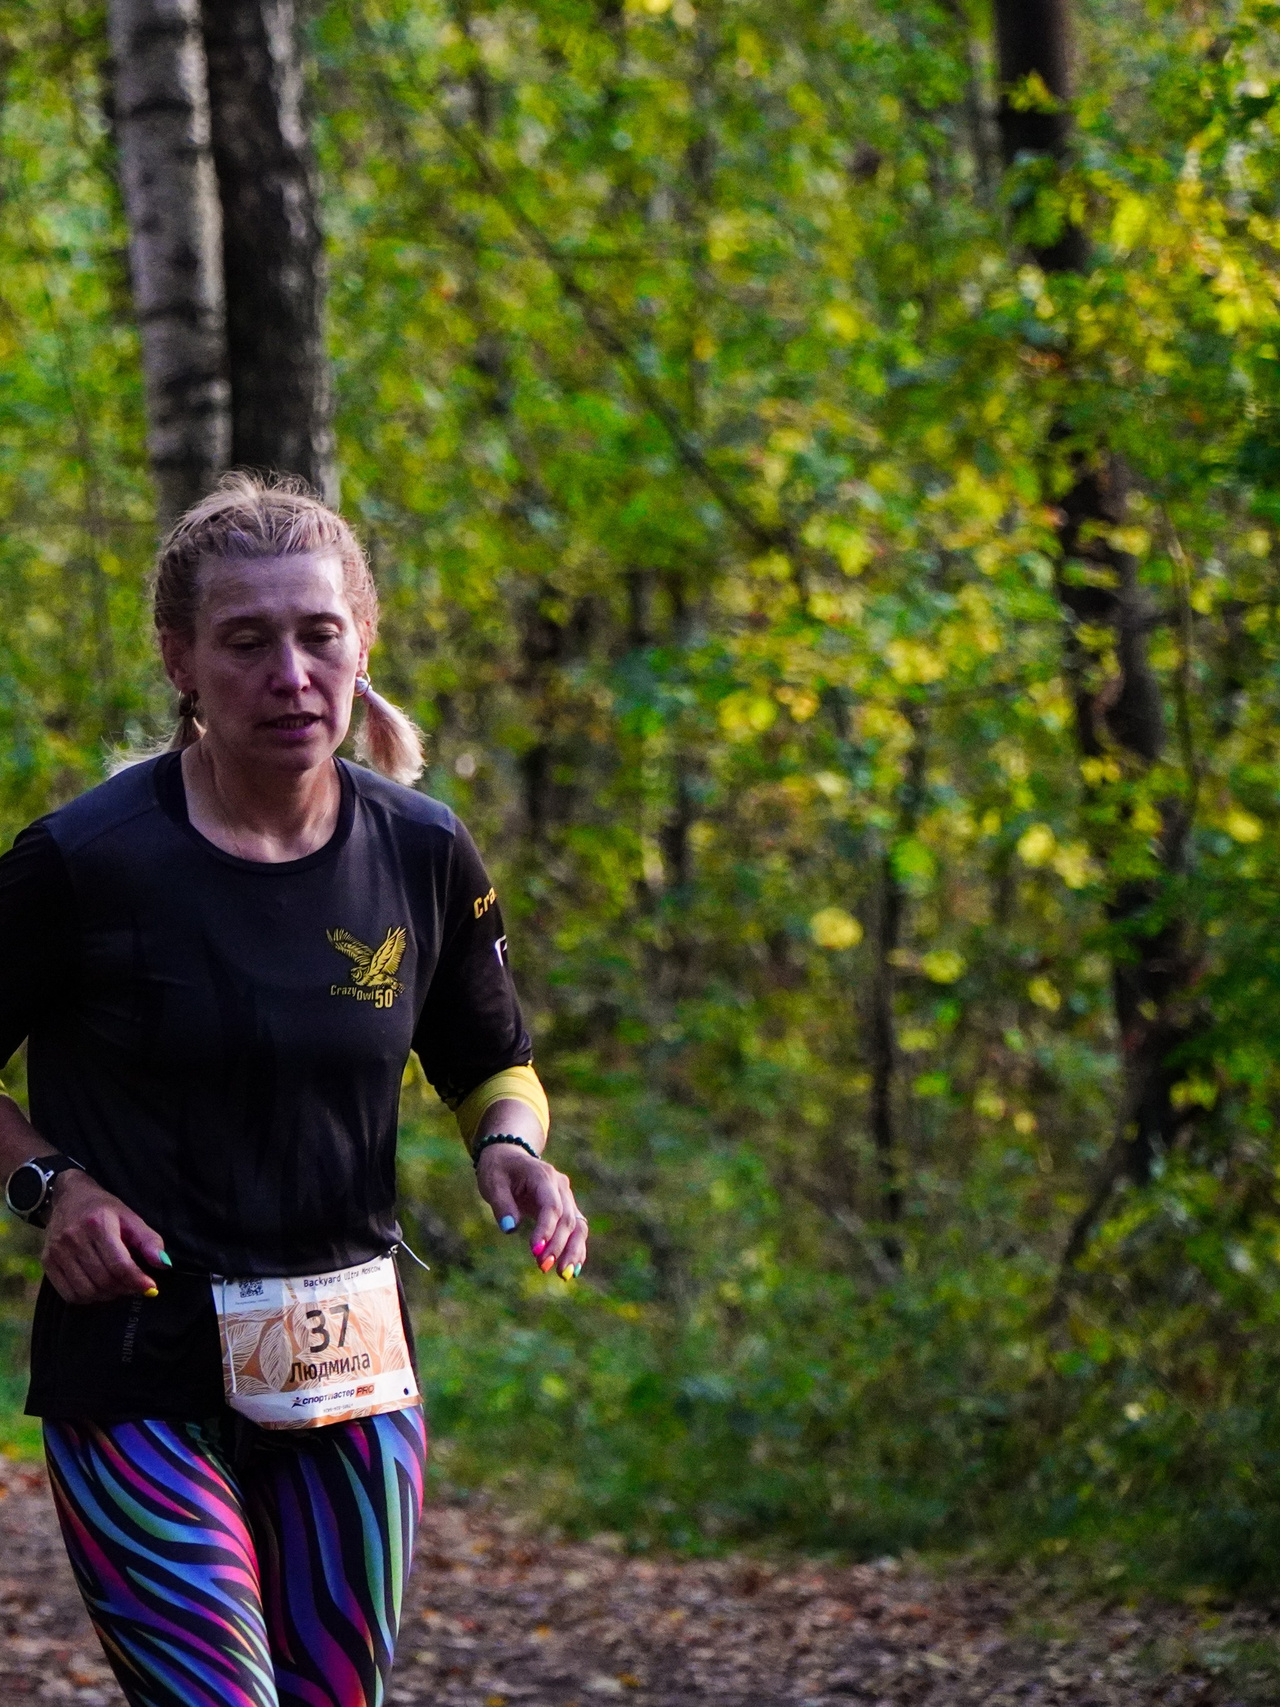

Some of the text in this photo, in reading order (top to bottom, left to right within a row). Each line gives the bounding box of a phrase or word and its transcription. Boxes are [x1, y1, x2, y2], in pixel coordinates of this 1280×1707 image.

[473, 887, 498, 919] Cra
[330, 984, 394, 1008] Crazy Owl 50
[303, 1265, 382, 1288] Backyard Ultra Moscow
[305, 1303, 350, 1354] 37
[289, 1353, 371, 1384] Людмила
[356, 1385, 375, 1397] PRO
